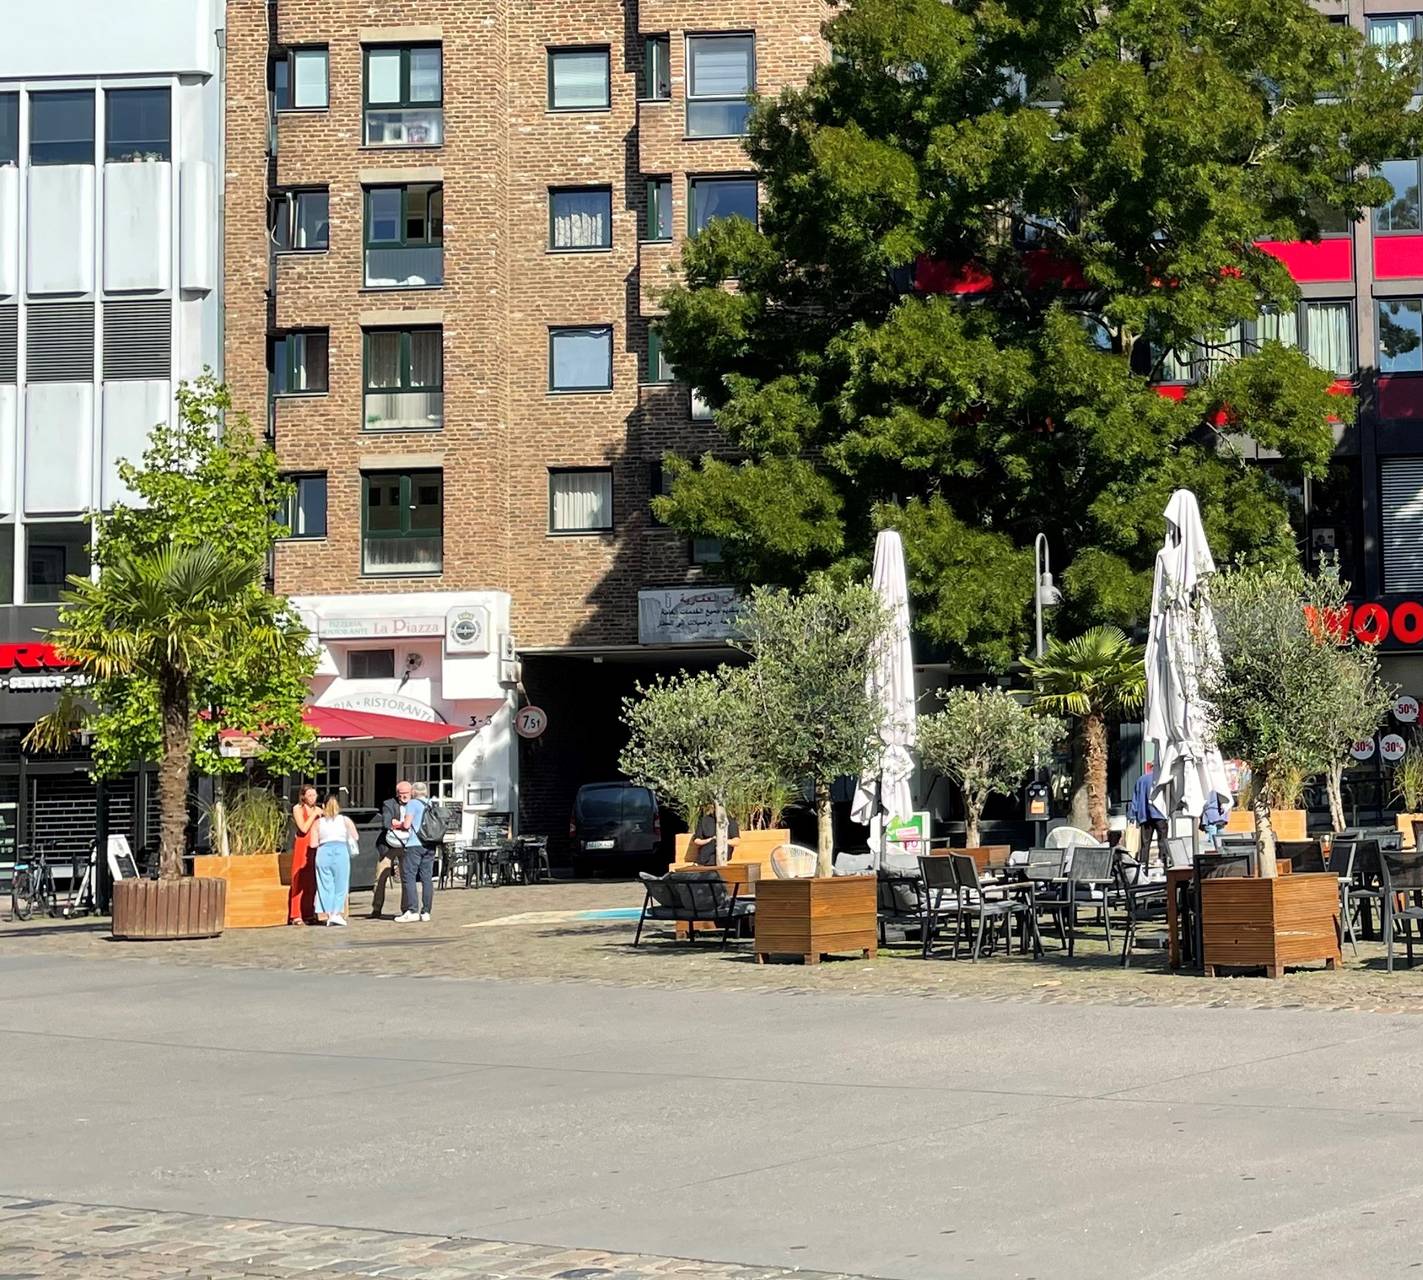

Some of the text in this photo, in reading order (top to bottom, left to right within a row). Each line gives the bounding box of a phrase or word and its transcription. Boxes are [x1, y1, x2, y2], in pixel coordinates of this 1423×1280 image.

[392, 619, 439, 634] Piazza
[1395, 703, 1417, 714] -50%
[1382, 742, 1404, 753] -30%
